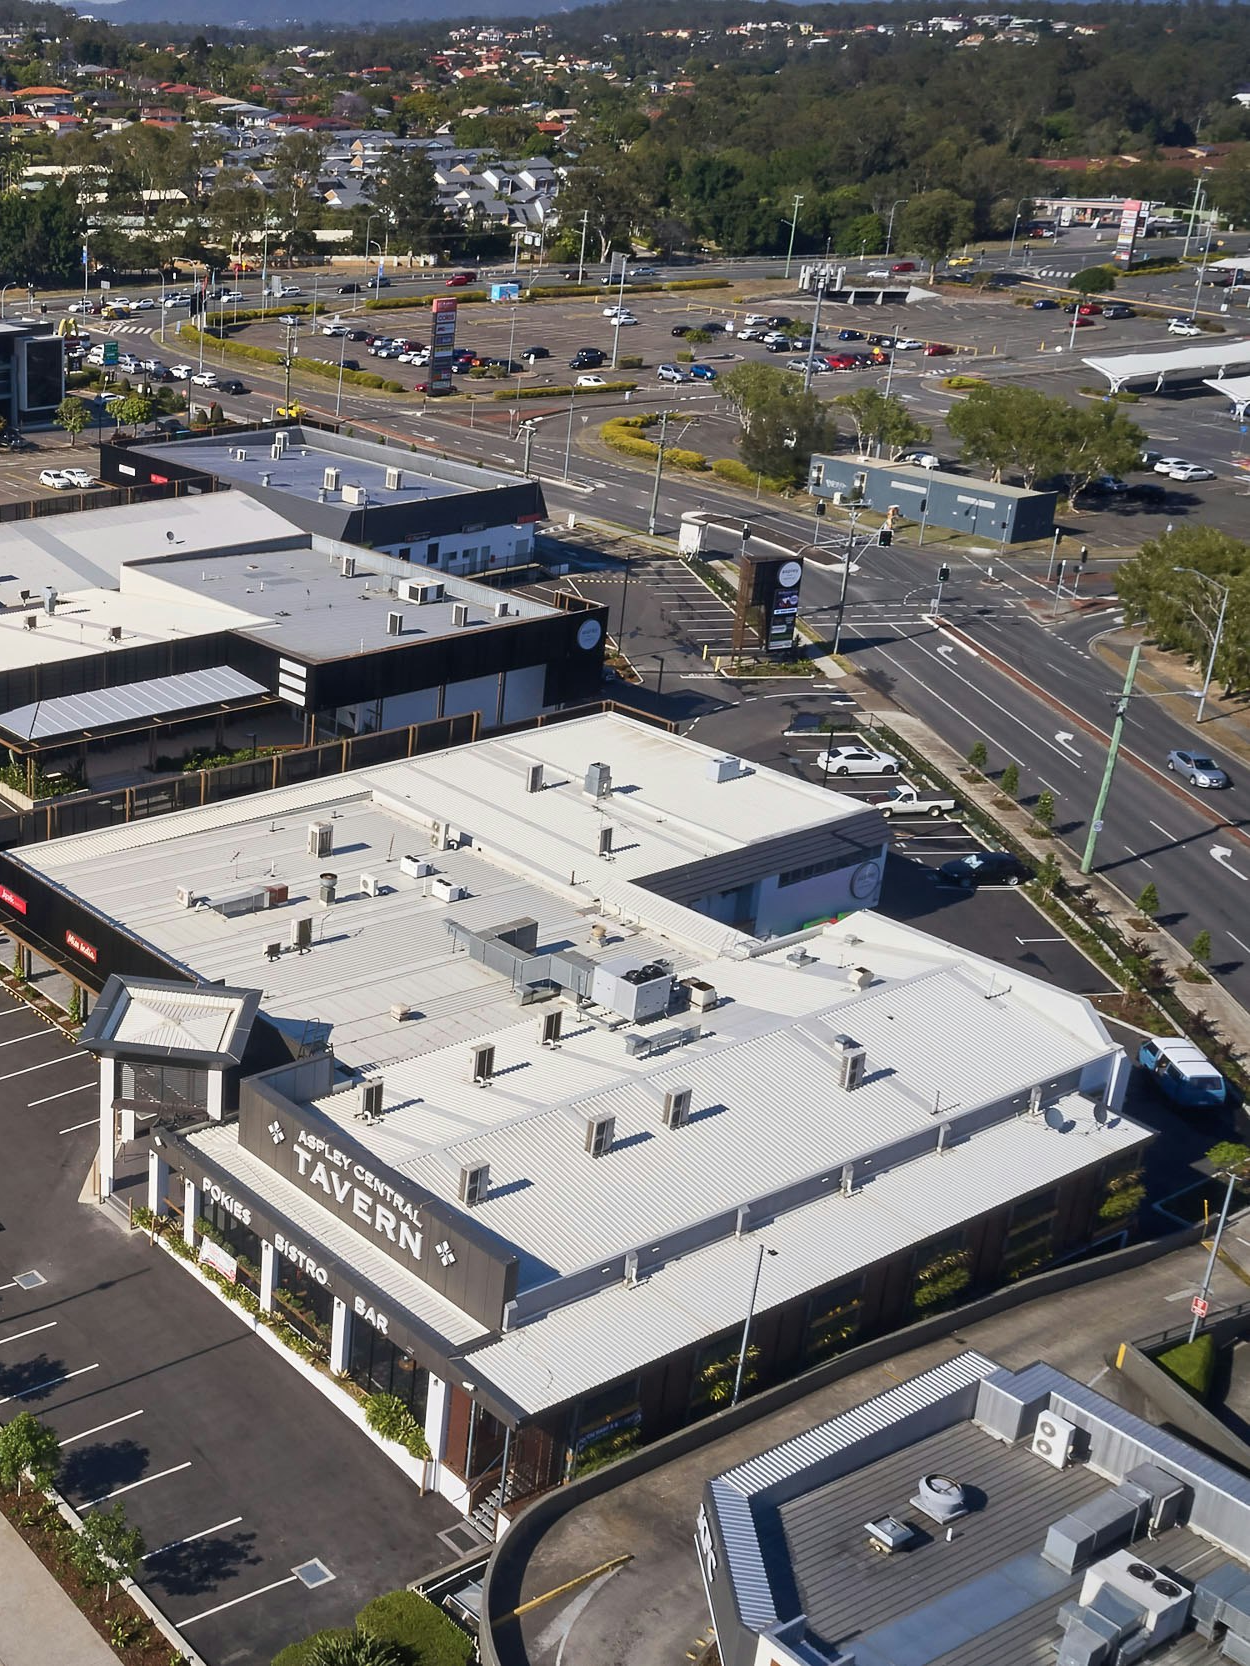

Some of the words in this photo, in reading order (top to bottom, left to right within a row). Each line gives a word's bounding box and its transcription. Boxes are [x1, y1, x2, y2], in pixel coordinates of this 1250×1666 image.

[201, 1176, 252, 1227] POKIES
[293, 1144, 423, 1261] TAVERN
[298, 1130, 353, 1171] ASPLEY
[353, 1165, 424, 1229] CENTRAL
[273, 1233, 330, 1287] BISTRO
[353, 1295, 389, 1335] BAR
